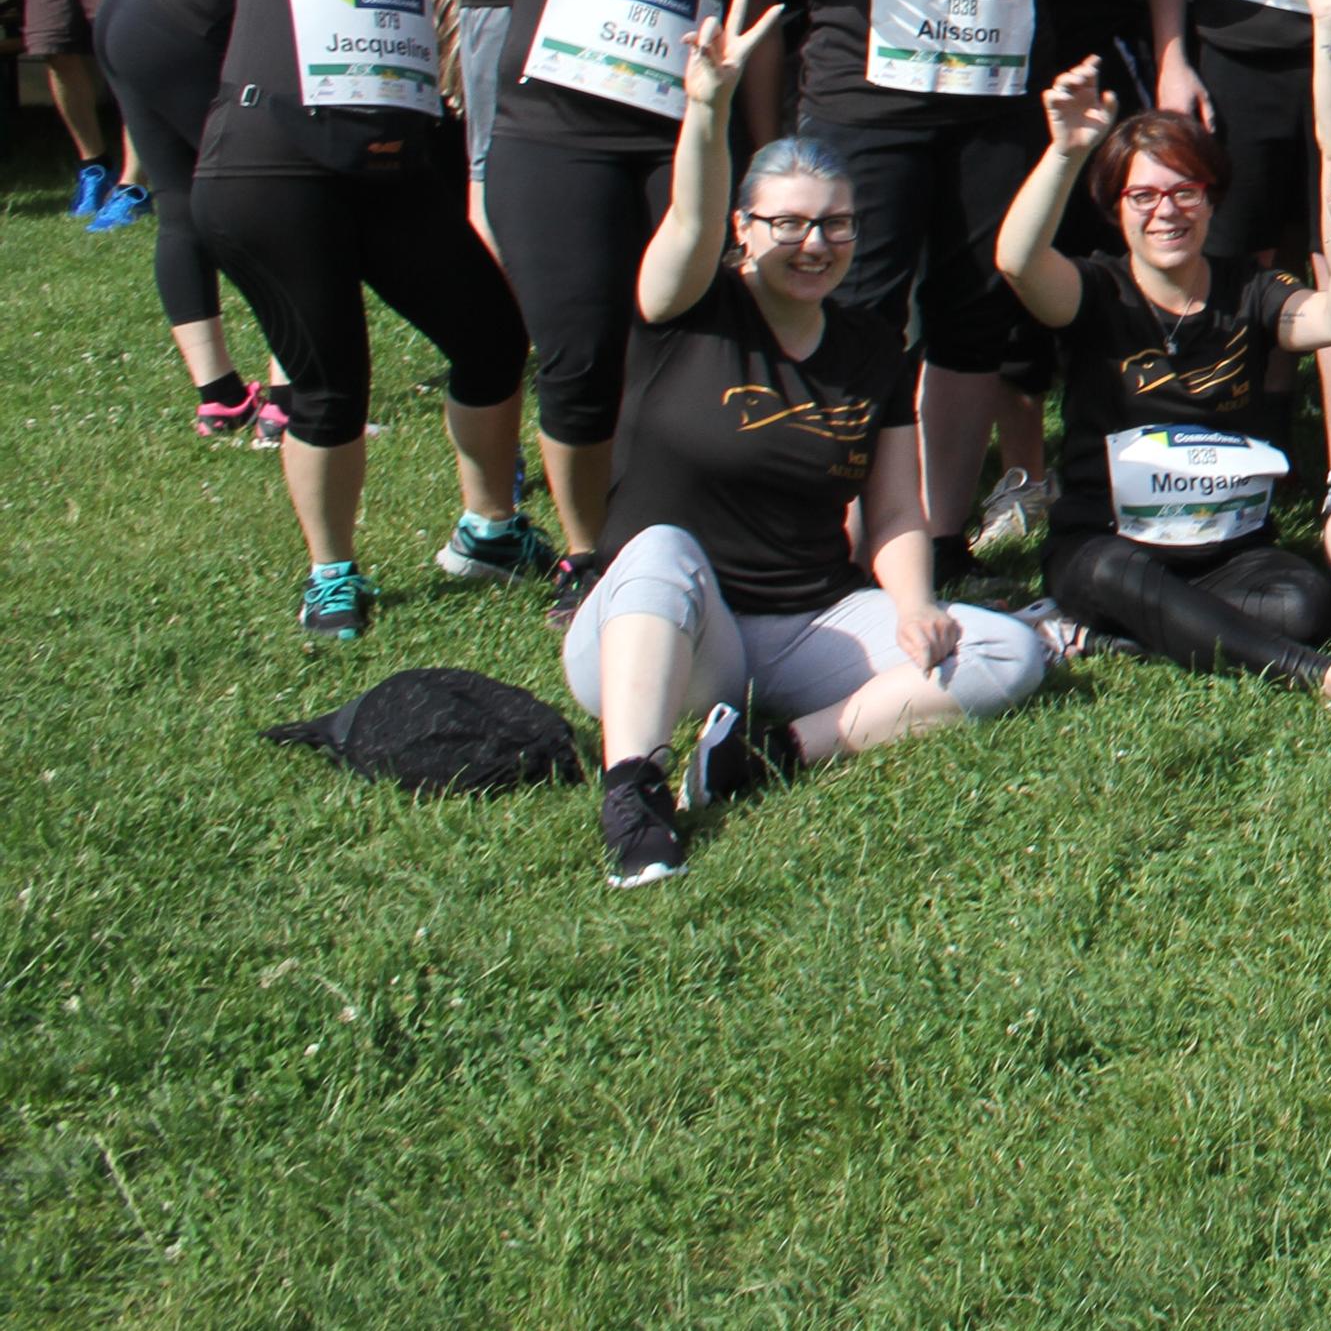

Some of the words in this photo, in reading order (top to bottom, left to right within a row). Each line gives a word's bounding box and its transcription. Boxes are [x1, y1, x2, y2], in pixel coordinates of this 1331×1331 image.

[600, 21, 670, 59] Sarah
[917, 19, 1001, 44] Alisson
[326, 33, 432, 62] Jacqueline
